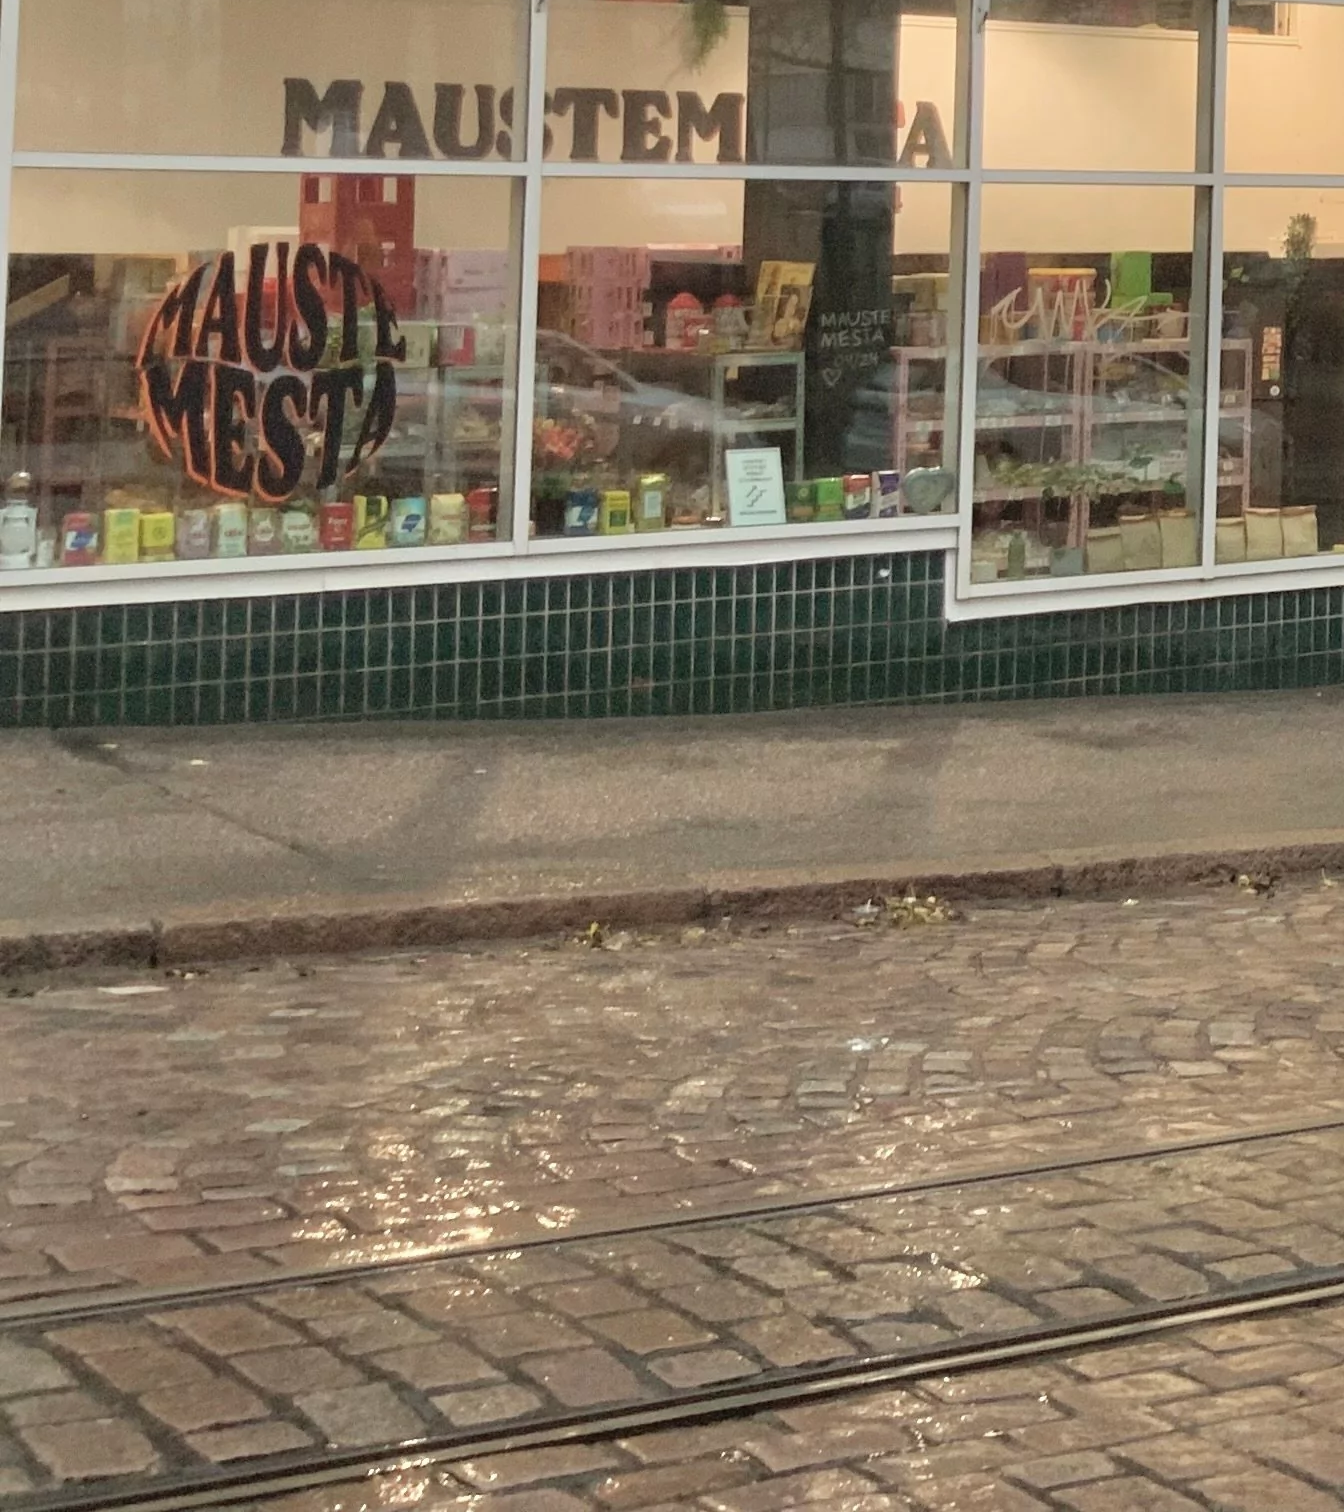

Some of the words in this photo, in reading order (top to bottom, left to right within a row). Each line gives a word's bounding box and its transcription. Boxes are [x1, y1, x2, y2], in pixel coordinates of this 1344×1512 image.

[136, 242, 406, 373] MAUSTE
[821, 310, 891, 327] MAUSTE
[821, 328, 884, 348] MESTA
[138, 360, 397, 502] MESTA
